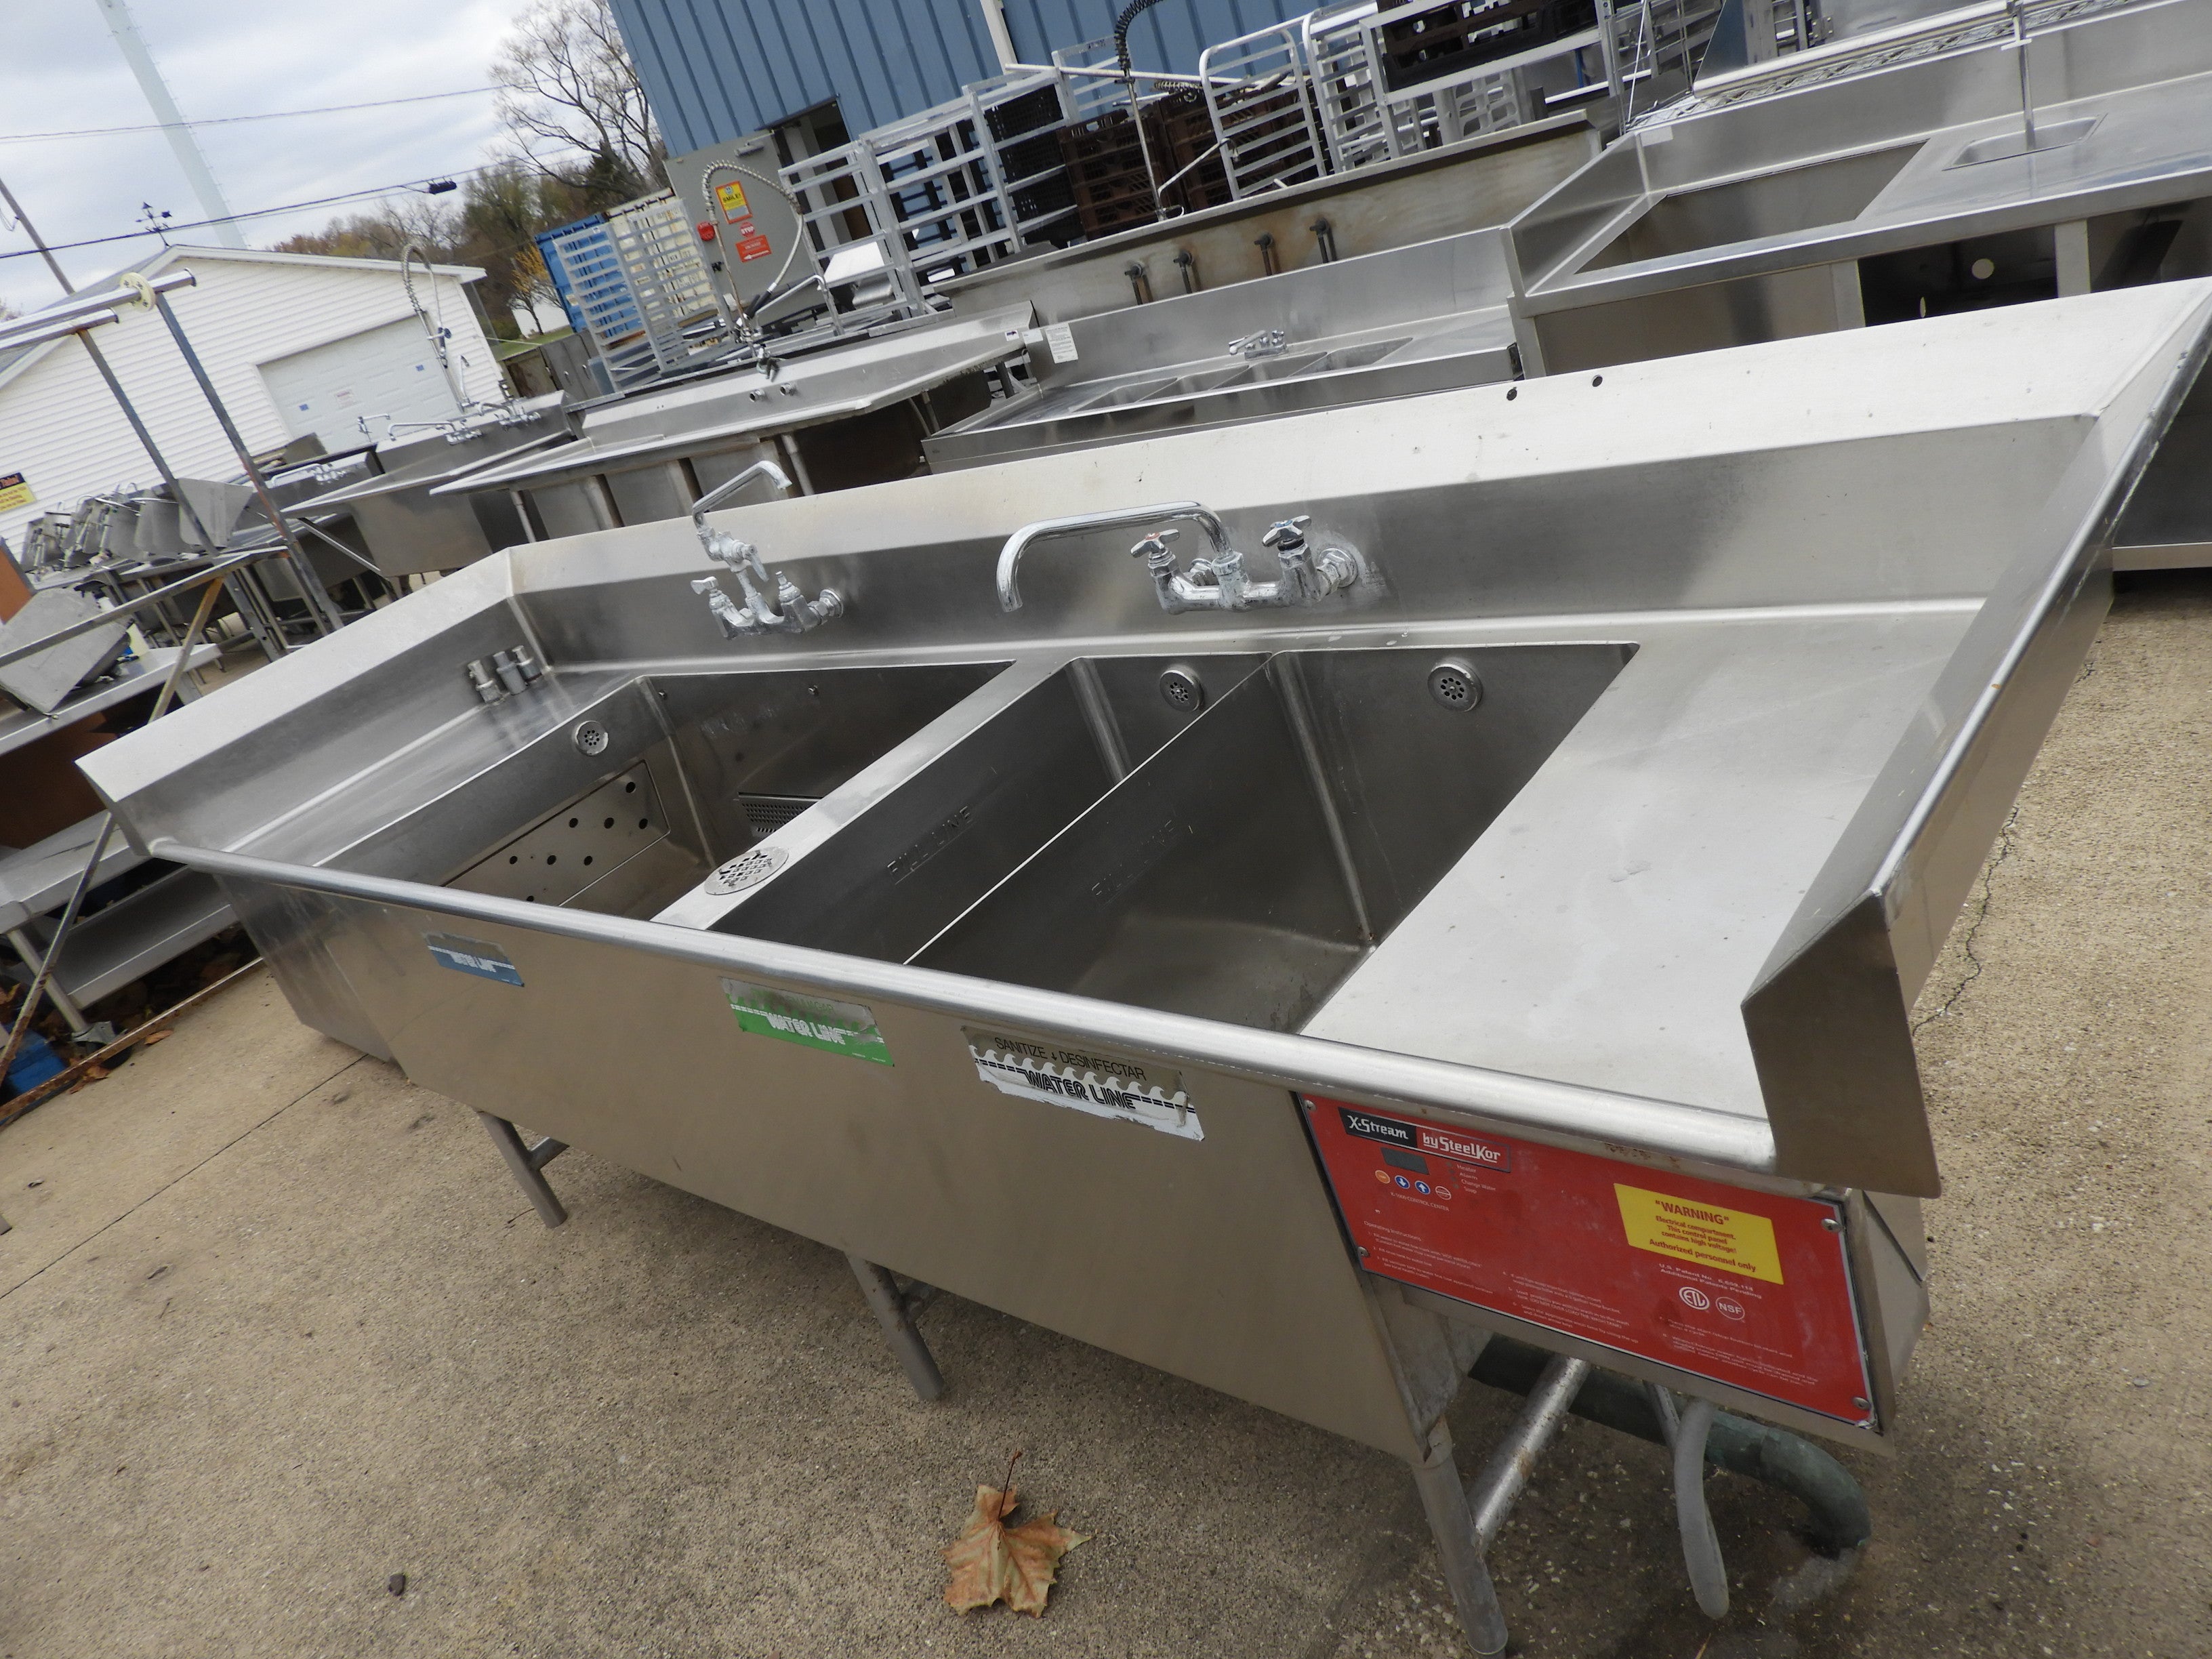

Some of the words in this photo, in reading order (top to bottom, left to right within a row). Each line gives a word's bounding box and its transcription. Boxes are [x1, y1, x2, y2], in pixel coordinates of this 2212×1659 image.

[722, 194, 741, 203] SMILE!
[741, 226, 754, 234] STOP
[766, 1012, 813, 1037] WATER
[810, 1021, 846, 1045] LINE
[995, 1037, 1047, 1059] SANITIZE
[1059, 1050, 1147, 1081] DESINFECTAR
[1025, 1069, 1088, 1101] WATER
[1091, 1086, 1136, 1109] LINE
[1420, 1133, 1439, 1147] by
[1437, 1137, 1502, 1162] SteelKor
[1655, 1201, 1729, 1225] "WARNING"
[1656, 1216, 1685, 1227] Electrical
[1661, 1231, 1689, 1241] contains
[1691, 1238, 1706, 1246] high
[1708, 1242, 1736, 1254] voltage!
[1681, 1229, 1706, 1238] control
[1708, 1235, 1727, 1244] panel
[1649, 1239, 1692, 1254] Authorized
[1695, 1250, 1735, 1266] personnel
[1738, 1261, 1756, 1271] only
[1660, 1269, 1697, 1281] Additional
[1700, 1279, 1727, 1289] Patents
[1729, 1287, 1761, 1298] Pending
[1719, 1303, 1742, 1314] NSF
